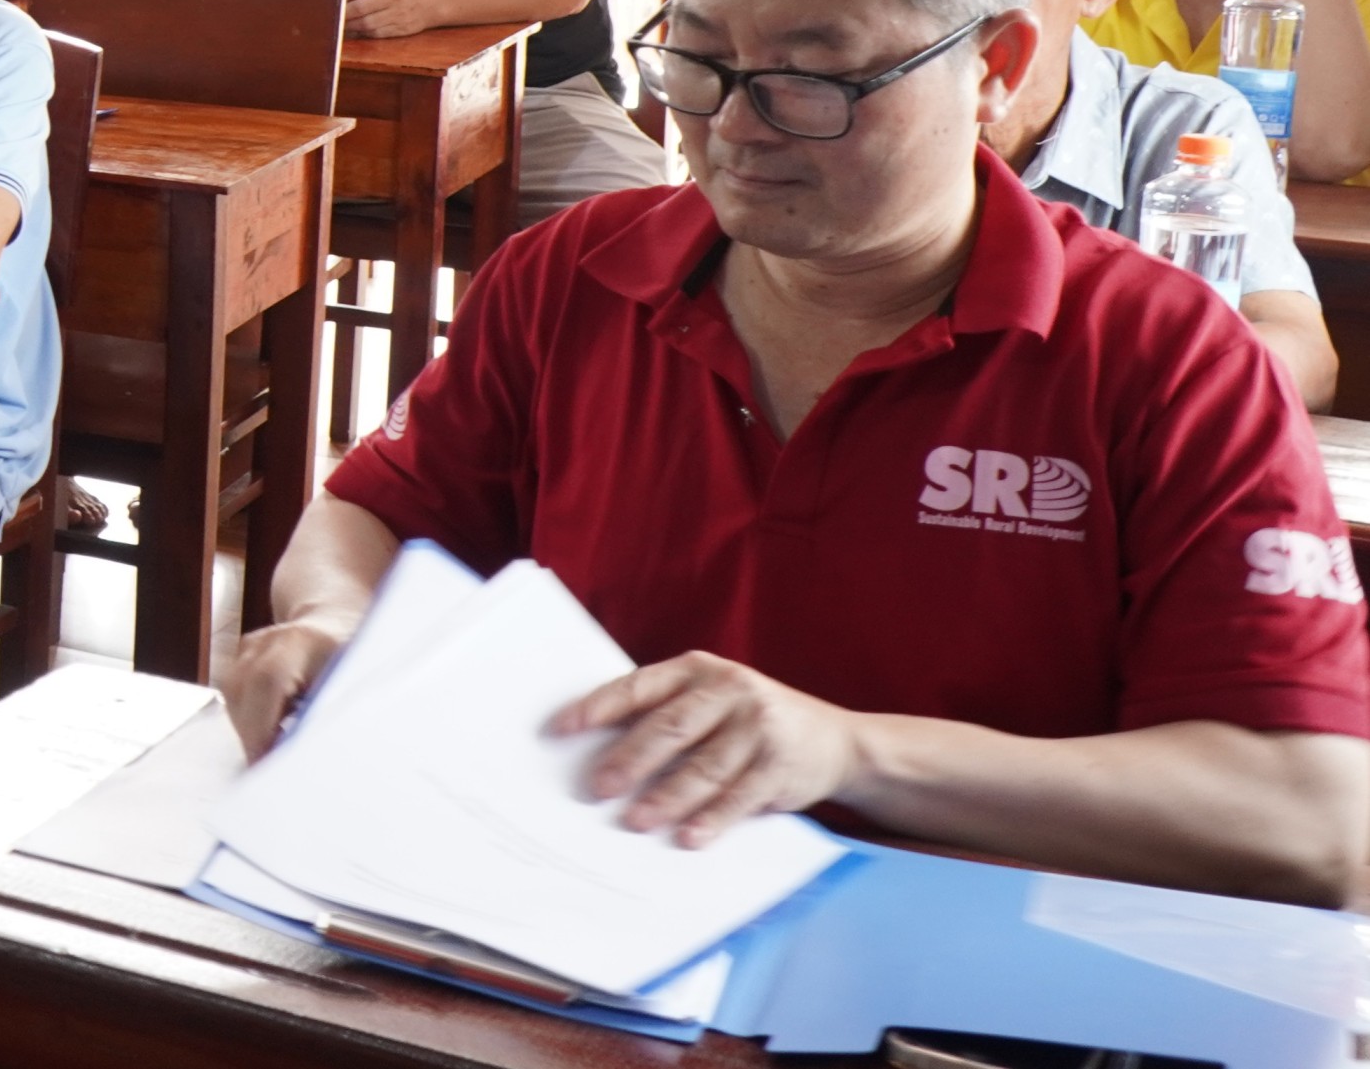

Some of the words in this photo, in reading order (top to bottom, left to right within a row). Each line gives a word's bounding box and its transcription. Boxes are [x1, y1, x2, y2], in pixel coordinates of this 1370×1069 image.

[917, 444, 1092, 523] SRD
[917, 509, 982, 530] Sustainable
[984, 516, 1016, 534] Rural
[1017, 520, 1086, 543] Development
